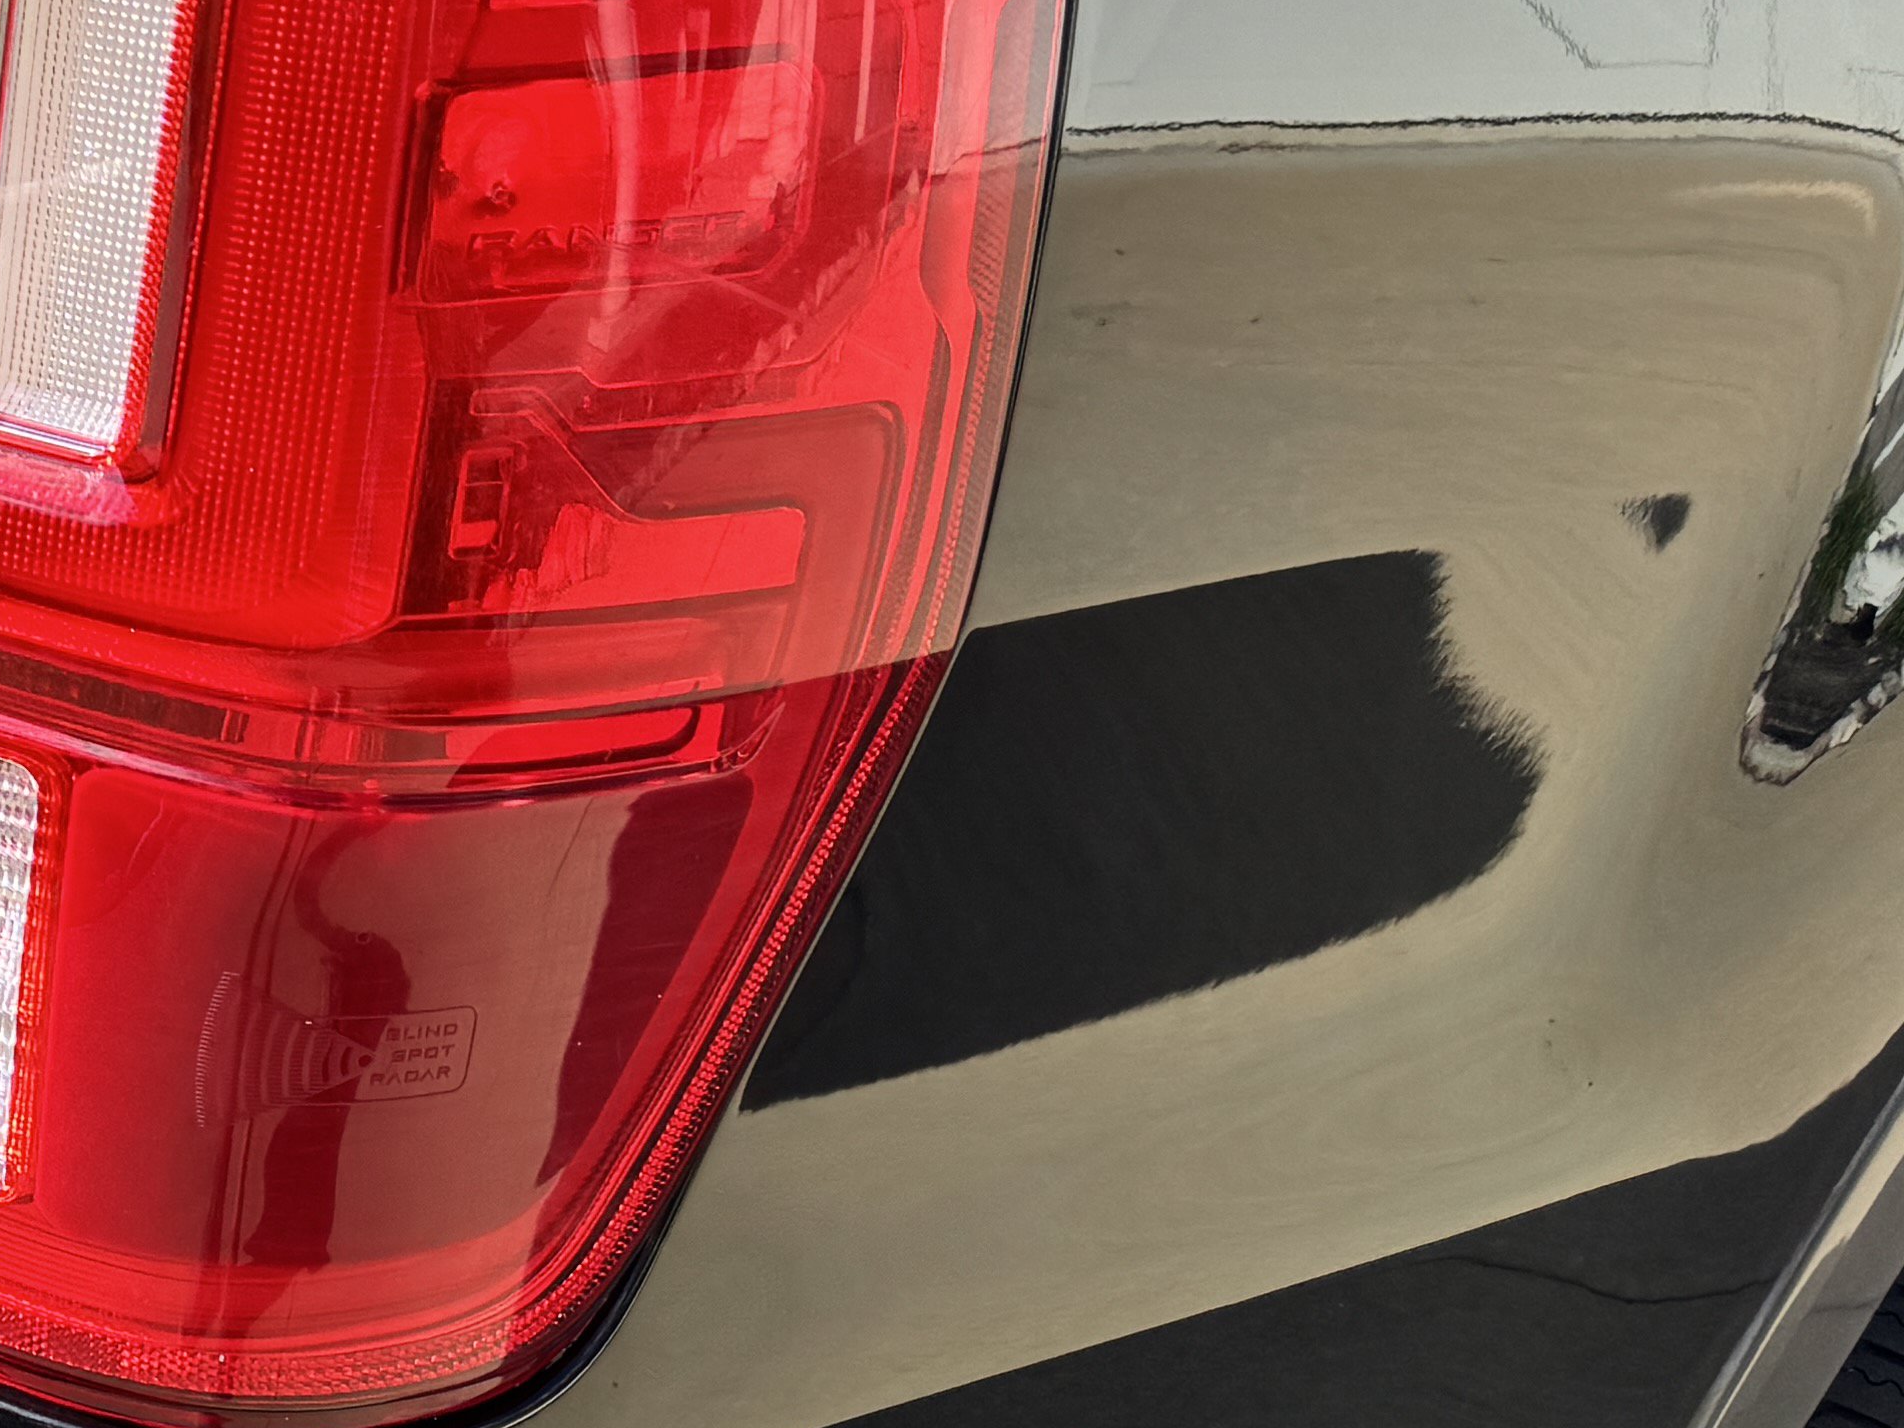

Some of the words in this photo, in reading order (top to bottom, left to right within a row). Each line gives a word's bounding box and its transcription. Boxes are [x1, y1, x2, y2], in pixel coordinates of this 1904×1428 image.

[385, 1023, 458, 1042] BLIND
[392, 1044, 455, 1063] SPOT
[370, 1065, 451, 1087] RADAR
